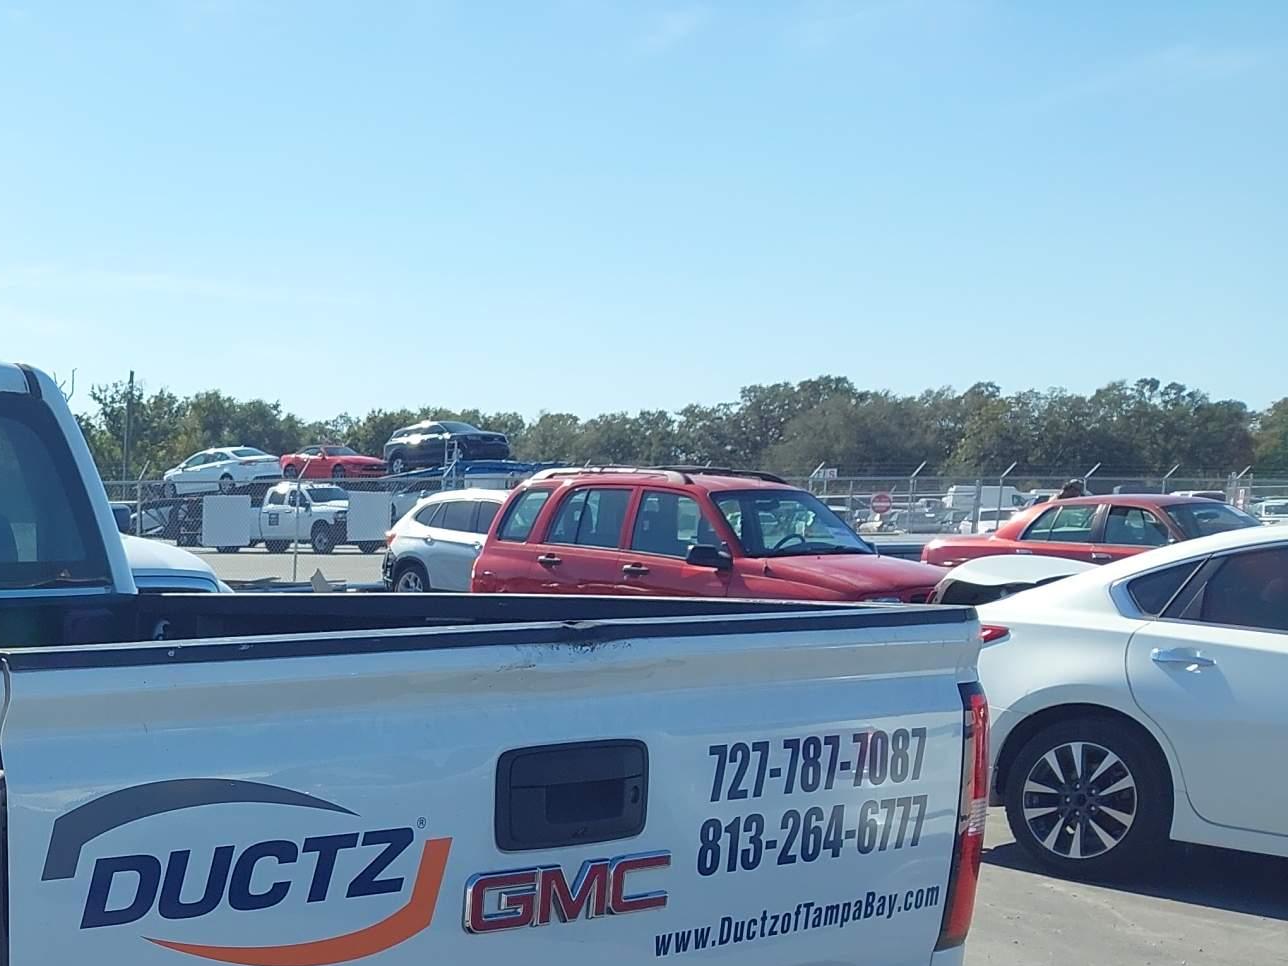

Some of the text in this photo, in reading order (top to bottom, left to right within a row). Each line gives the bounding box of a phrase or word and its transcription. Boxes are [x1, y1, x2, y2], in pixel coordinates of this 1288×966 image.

[709, 727, 927, 802] 727-787-7087
[697, 795, 928, 876] 813-264-6777
[80, 827, 414, 929] DUCTZ
[462, 849, 672, 934] GMC
[655, 886, 940, 957] www.DuctzofTampaBay.com
